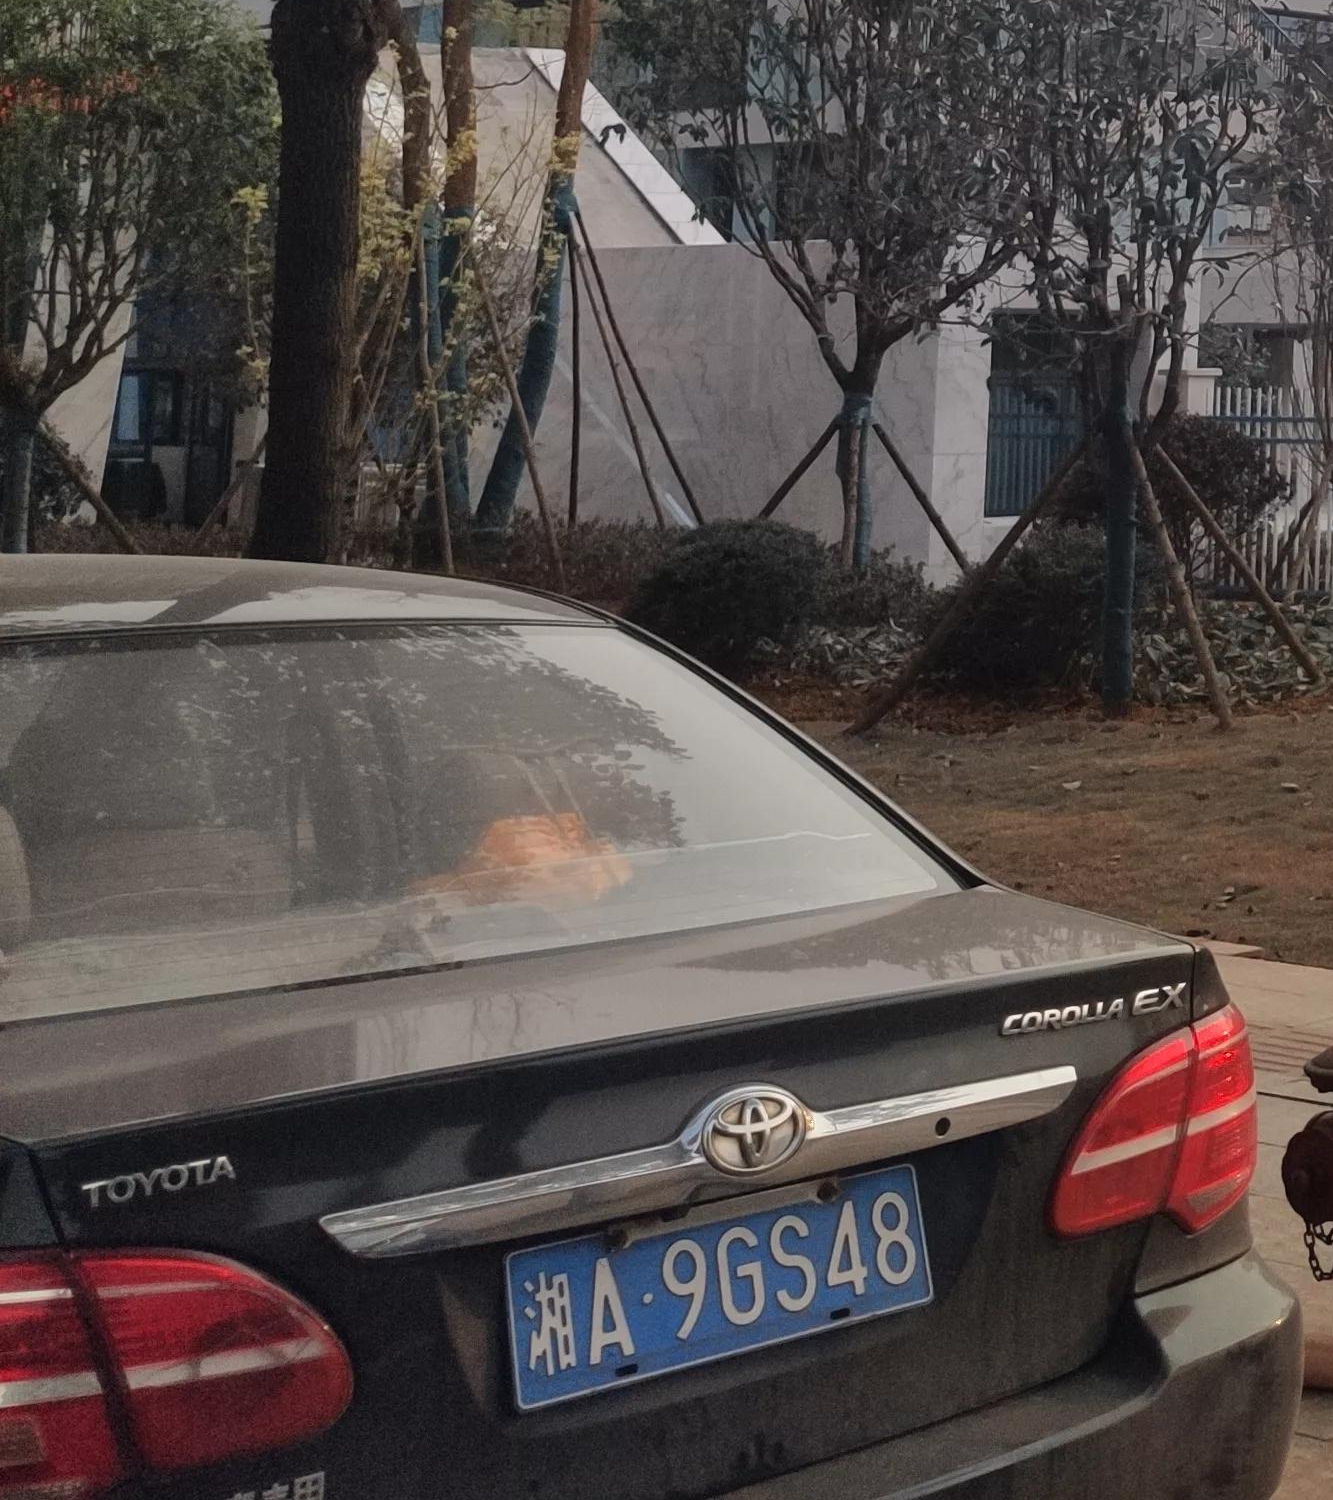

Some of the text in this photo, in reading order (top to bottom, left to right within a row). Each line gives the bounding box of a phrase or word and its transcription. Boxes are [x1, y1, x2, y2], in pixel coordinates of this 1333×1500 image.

[1001, 982, 1187, 1036] COROLLA EX
[81, 1155, 237, 1207] TOYOTA
